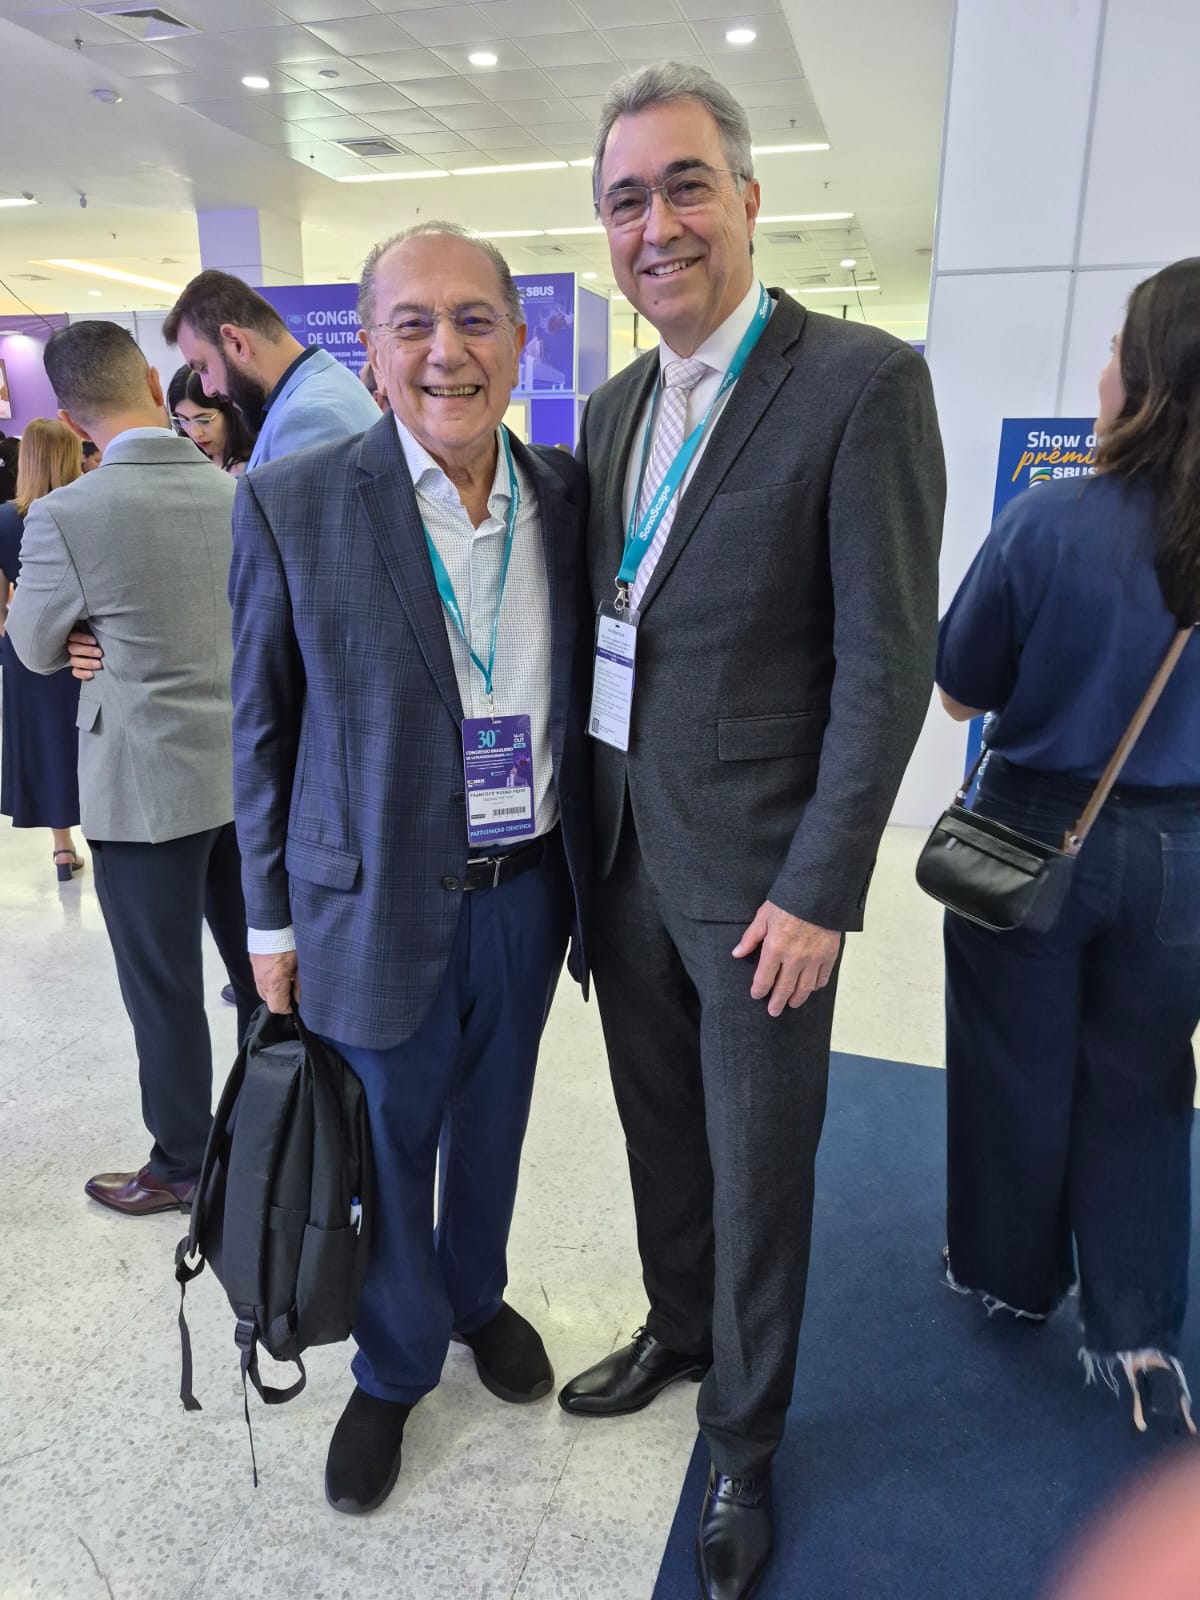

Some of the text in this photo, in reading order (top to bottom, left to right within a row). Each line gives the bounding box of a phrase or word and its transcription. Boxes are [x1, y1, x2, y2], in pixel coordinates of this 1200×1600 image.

[526, 286, 554, 297] SBUS
[306, 310, 362, 326] CONGR
[308, 331, 362, 345] DE ULTRA
[1027, 431, 1103, 448] Show d
[1011, 447, 1097, 482] prêmi
[1052, 466, 1098, 479] SBUS
[639, 485, 671, 541] SonoScape
